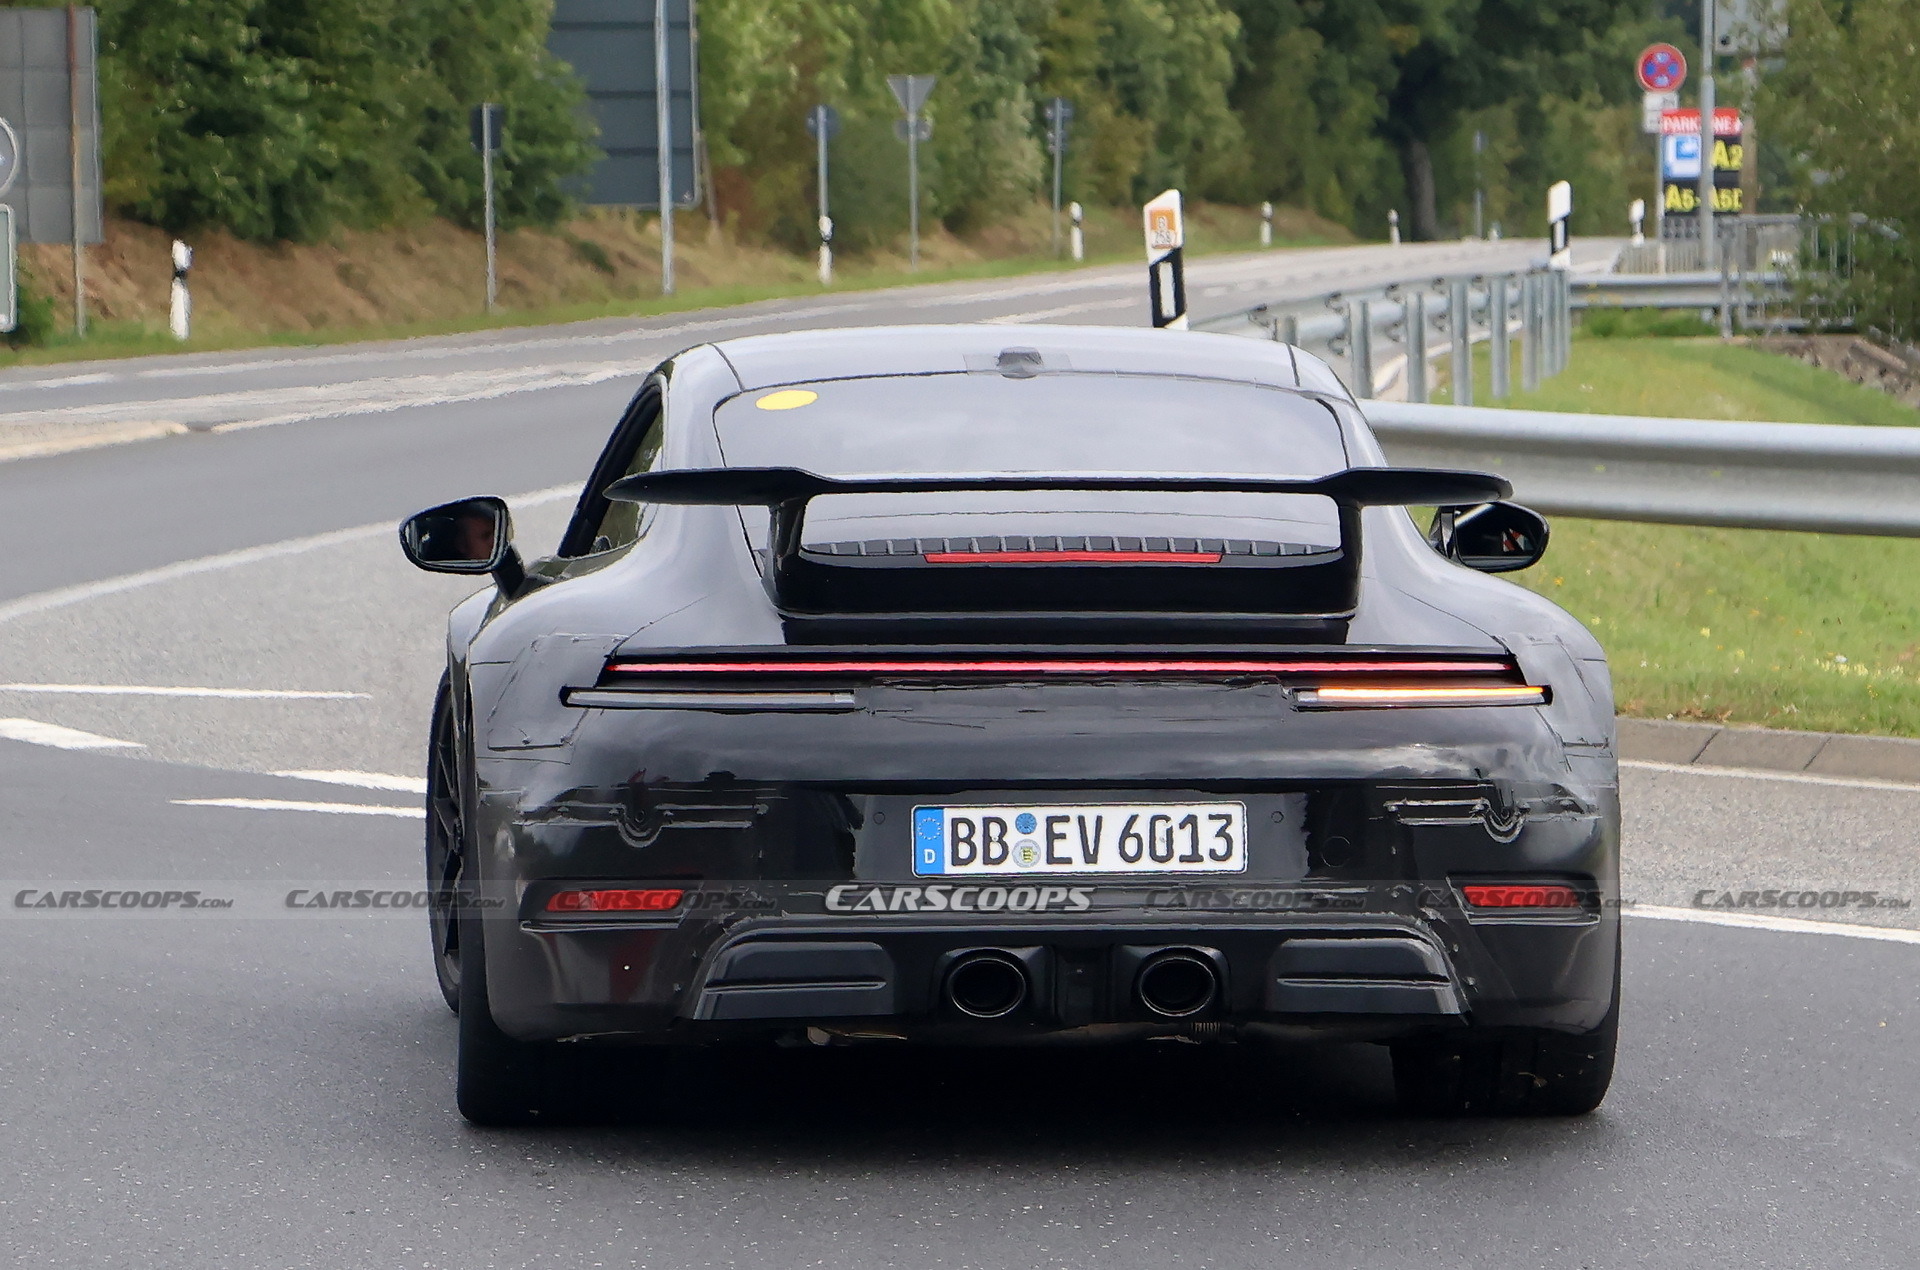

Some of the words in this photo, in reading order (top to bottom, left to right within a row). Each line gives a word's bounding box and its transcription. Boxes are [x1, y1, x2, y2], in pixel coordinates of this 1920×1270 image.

[924, 848, 936, 864] D
[950, 816, 1010, 866] BB
[1045, 815, 1103, 865] EV
[1117, 813, 1234, 864] 6013
